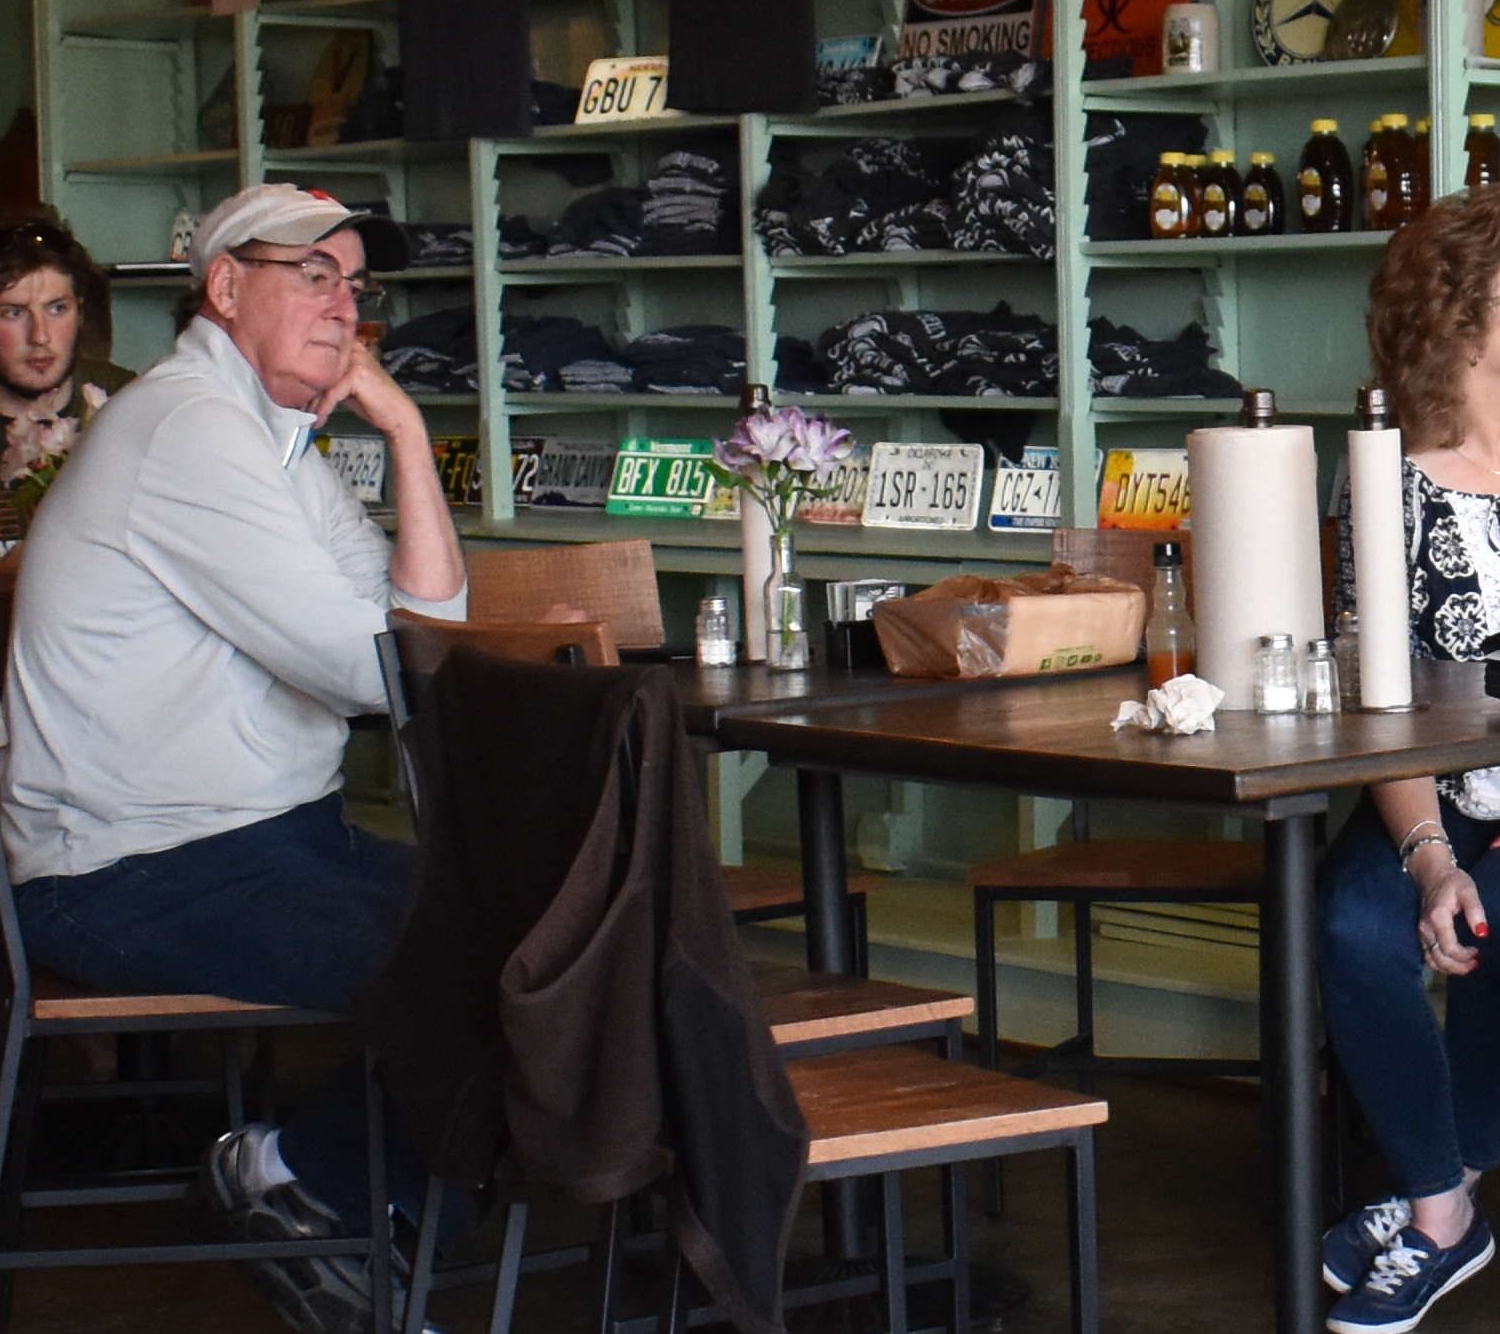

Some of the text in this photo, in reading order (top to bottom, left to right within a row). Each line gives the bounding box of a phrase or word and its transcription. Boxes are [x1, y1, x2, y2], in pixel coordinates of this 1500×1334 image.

[904, 29, 931, 56] NO
[938, 21, 1030, 54] SMOKING
[1088, 35, 1158, 61] ECTIOUS
[584, 78, 636, 114] GBU
[617, 457, 707, 497] BFX 815
[1000, 474, 1029, 513] CGZ
